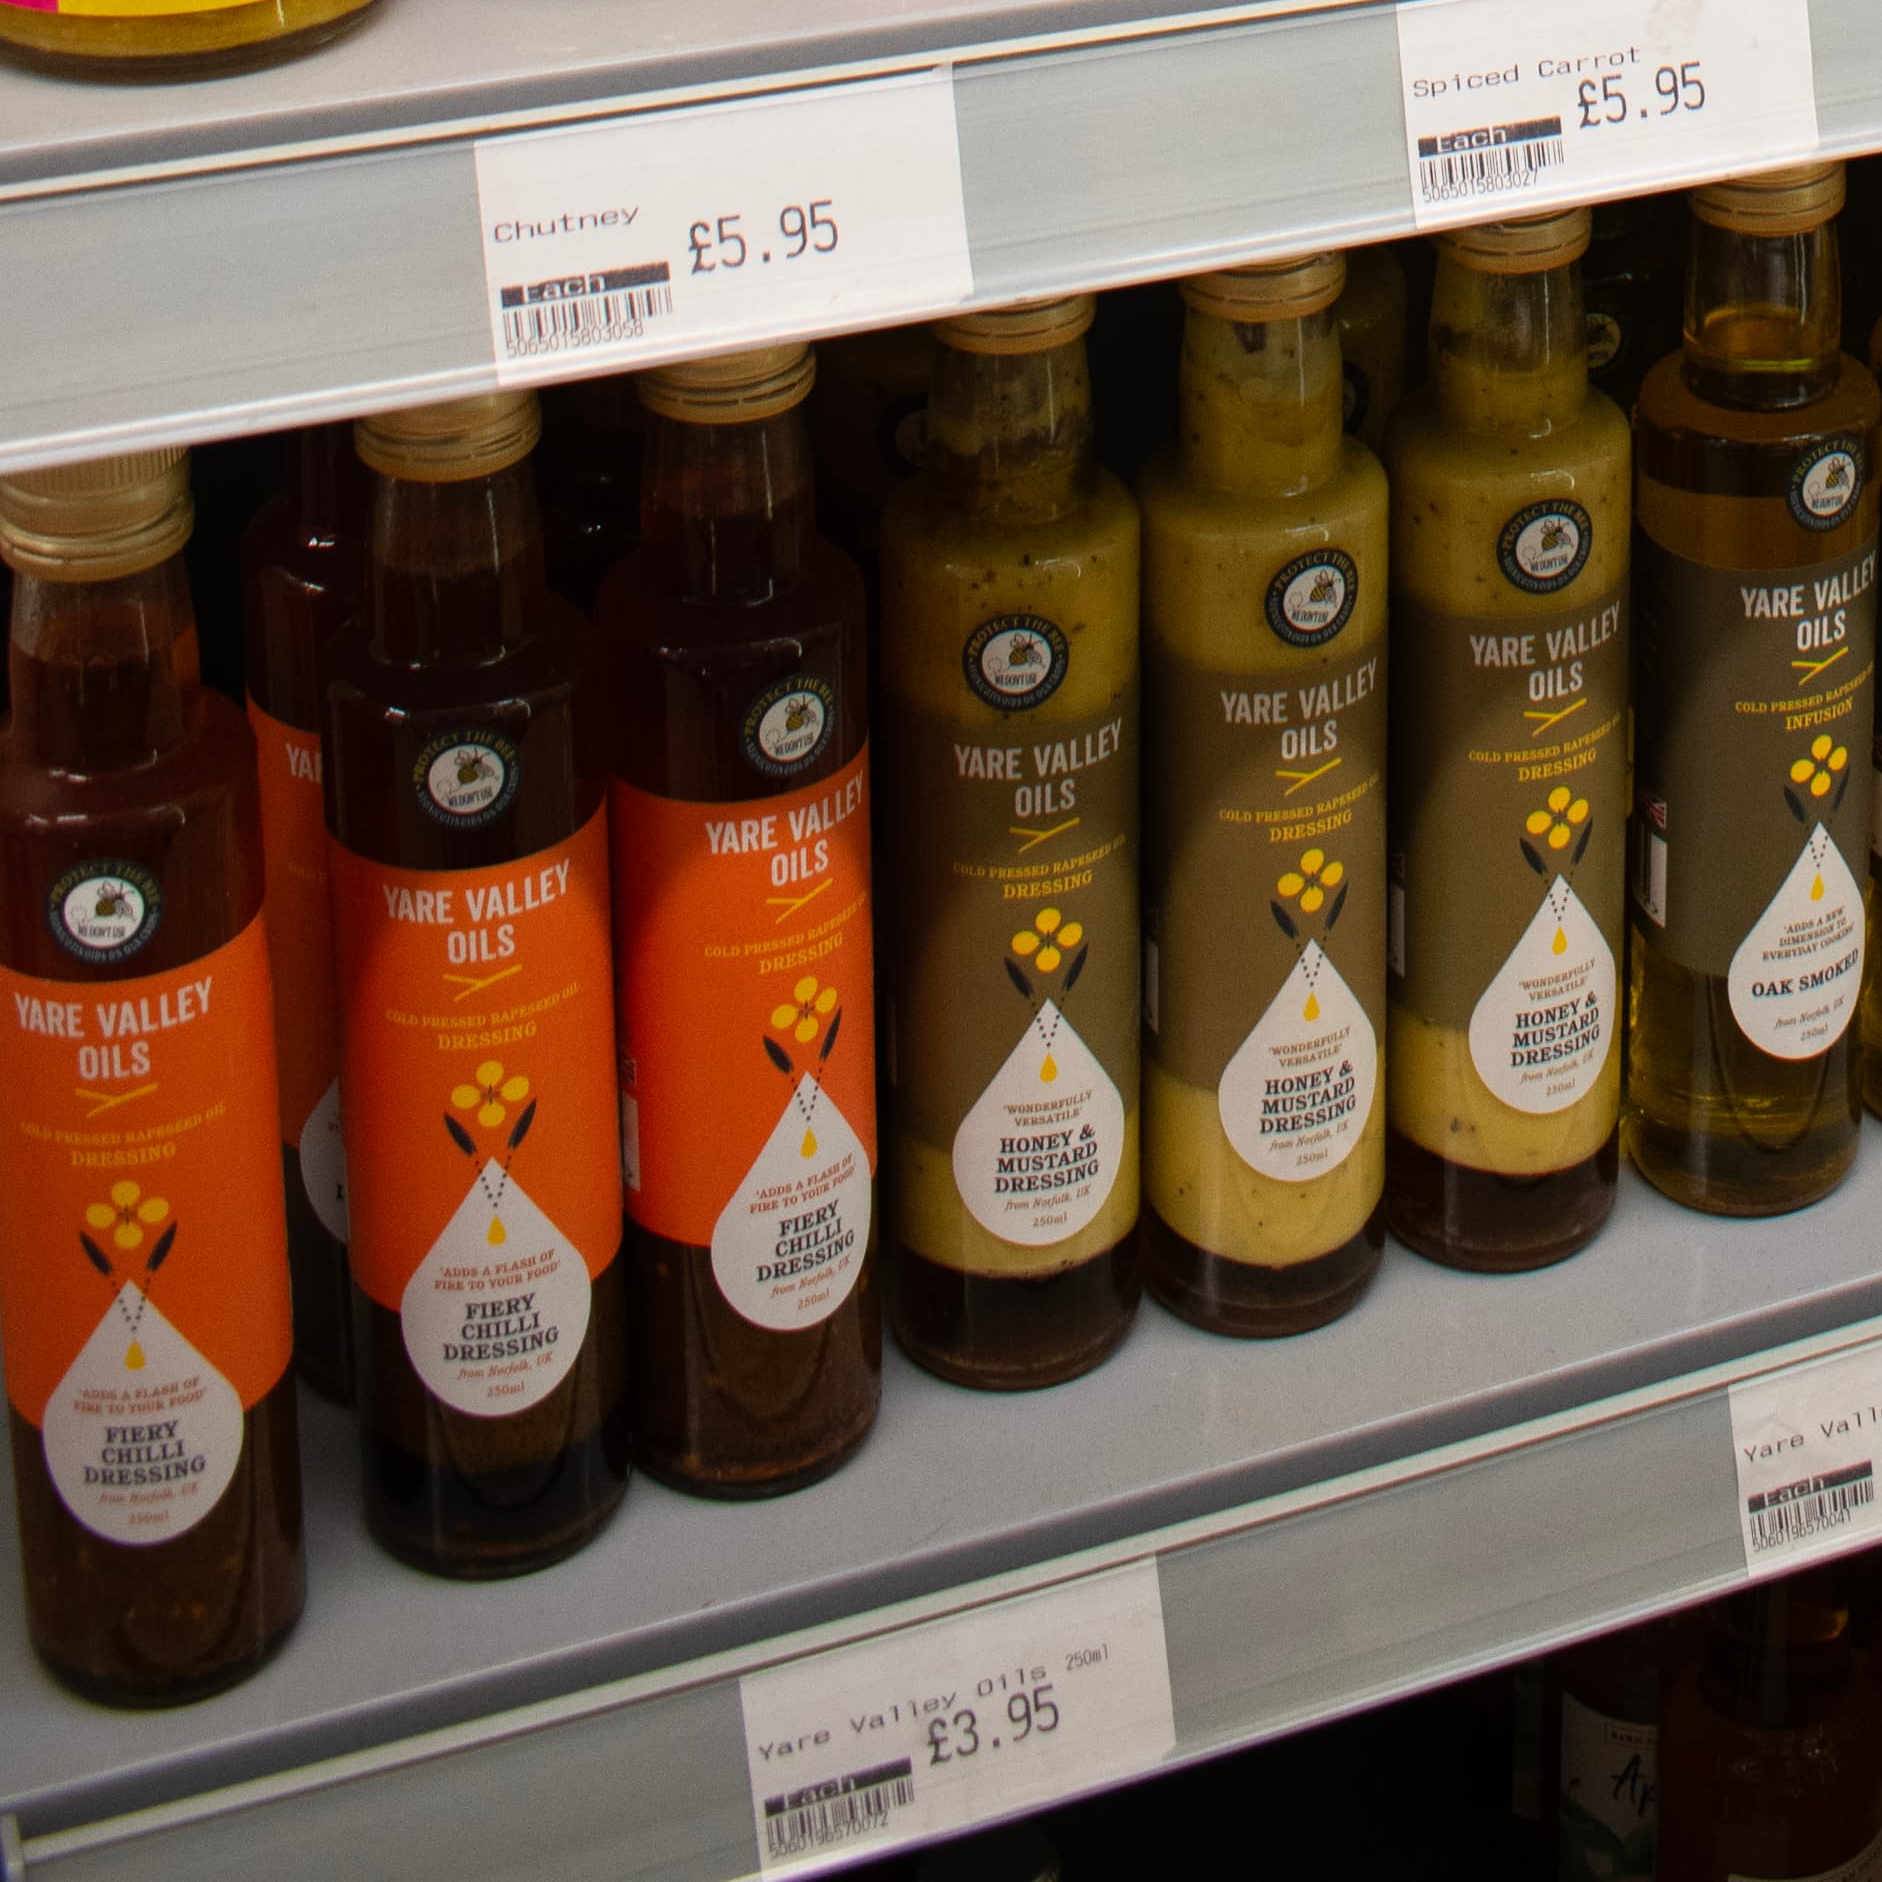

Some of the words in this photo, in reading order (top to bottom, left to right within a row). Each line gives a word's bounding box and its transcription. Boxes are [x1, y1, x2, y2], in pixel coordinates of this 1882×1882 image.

[1412, 65, 1521, 98] Spiced
[1538, 47, 1641, 78] Carrot
[1578, 61, 1706, 129] £5.95
[494, 206, 640, 243] Chutney
[688, 199, 839, 274] £5.95
[15, 991, 94, 1038] YARE
[98, 977, 213, 1036] VALLEY
[78, 1041, 150, 1080] OILS
[998, 1143, 1098, 1174] MUSTARD
[1000, 1129, 1074, 1154] HONEY
[995, 1160, 1099, 1194] DRESSING
[465, 1293, 536, 1320] FIERY
[443, 1328, 559, 1362] DRESSING
[461, 1313, 541, 1340] CHILLI
[758, 1729, 830, 1761] Yare
[850, 1692, 957, 1733] Valley
[977, 1665, 1047, 1698] Oils
[1065, 1645, 1109, 1671] 250ml
[927, 1684, 1059, 1766] £3.95
